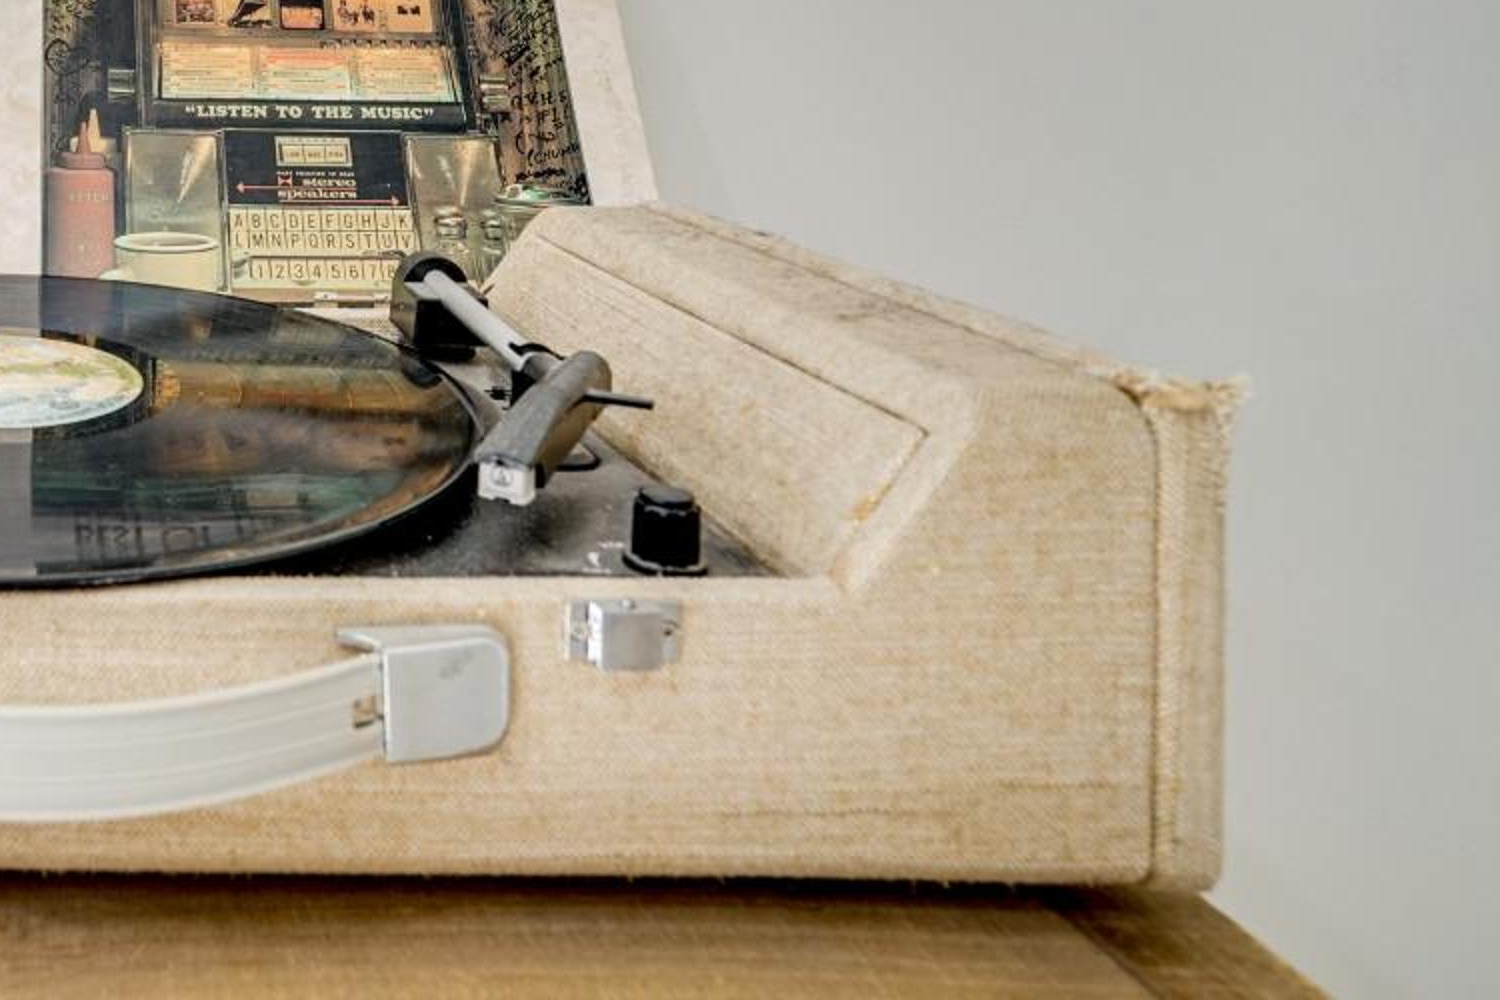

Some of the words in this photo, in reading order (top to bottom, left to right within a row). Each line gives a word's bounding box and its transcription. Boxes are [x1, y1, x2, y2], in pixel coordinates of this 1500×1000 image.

[275, 105, 302, 119] TO
[311, 105, 353, 119] THE
[277, 188, 357, 200] speakers
